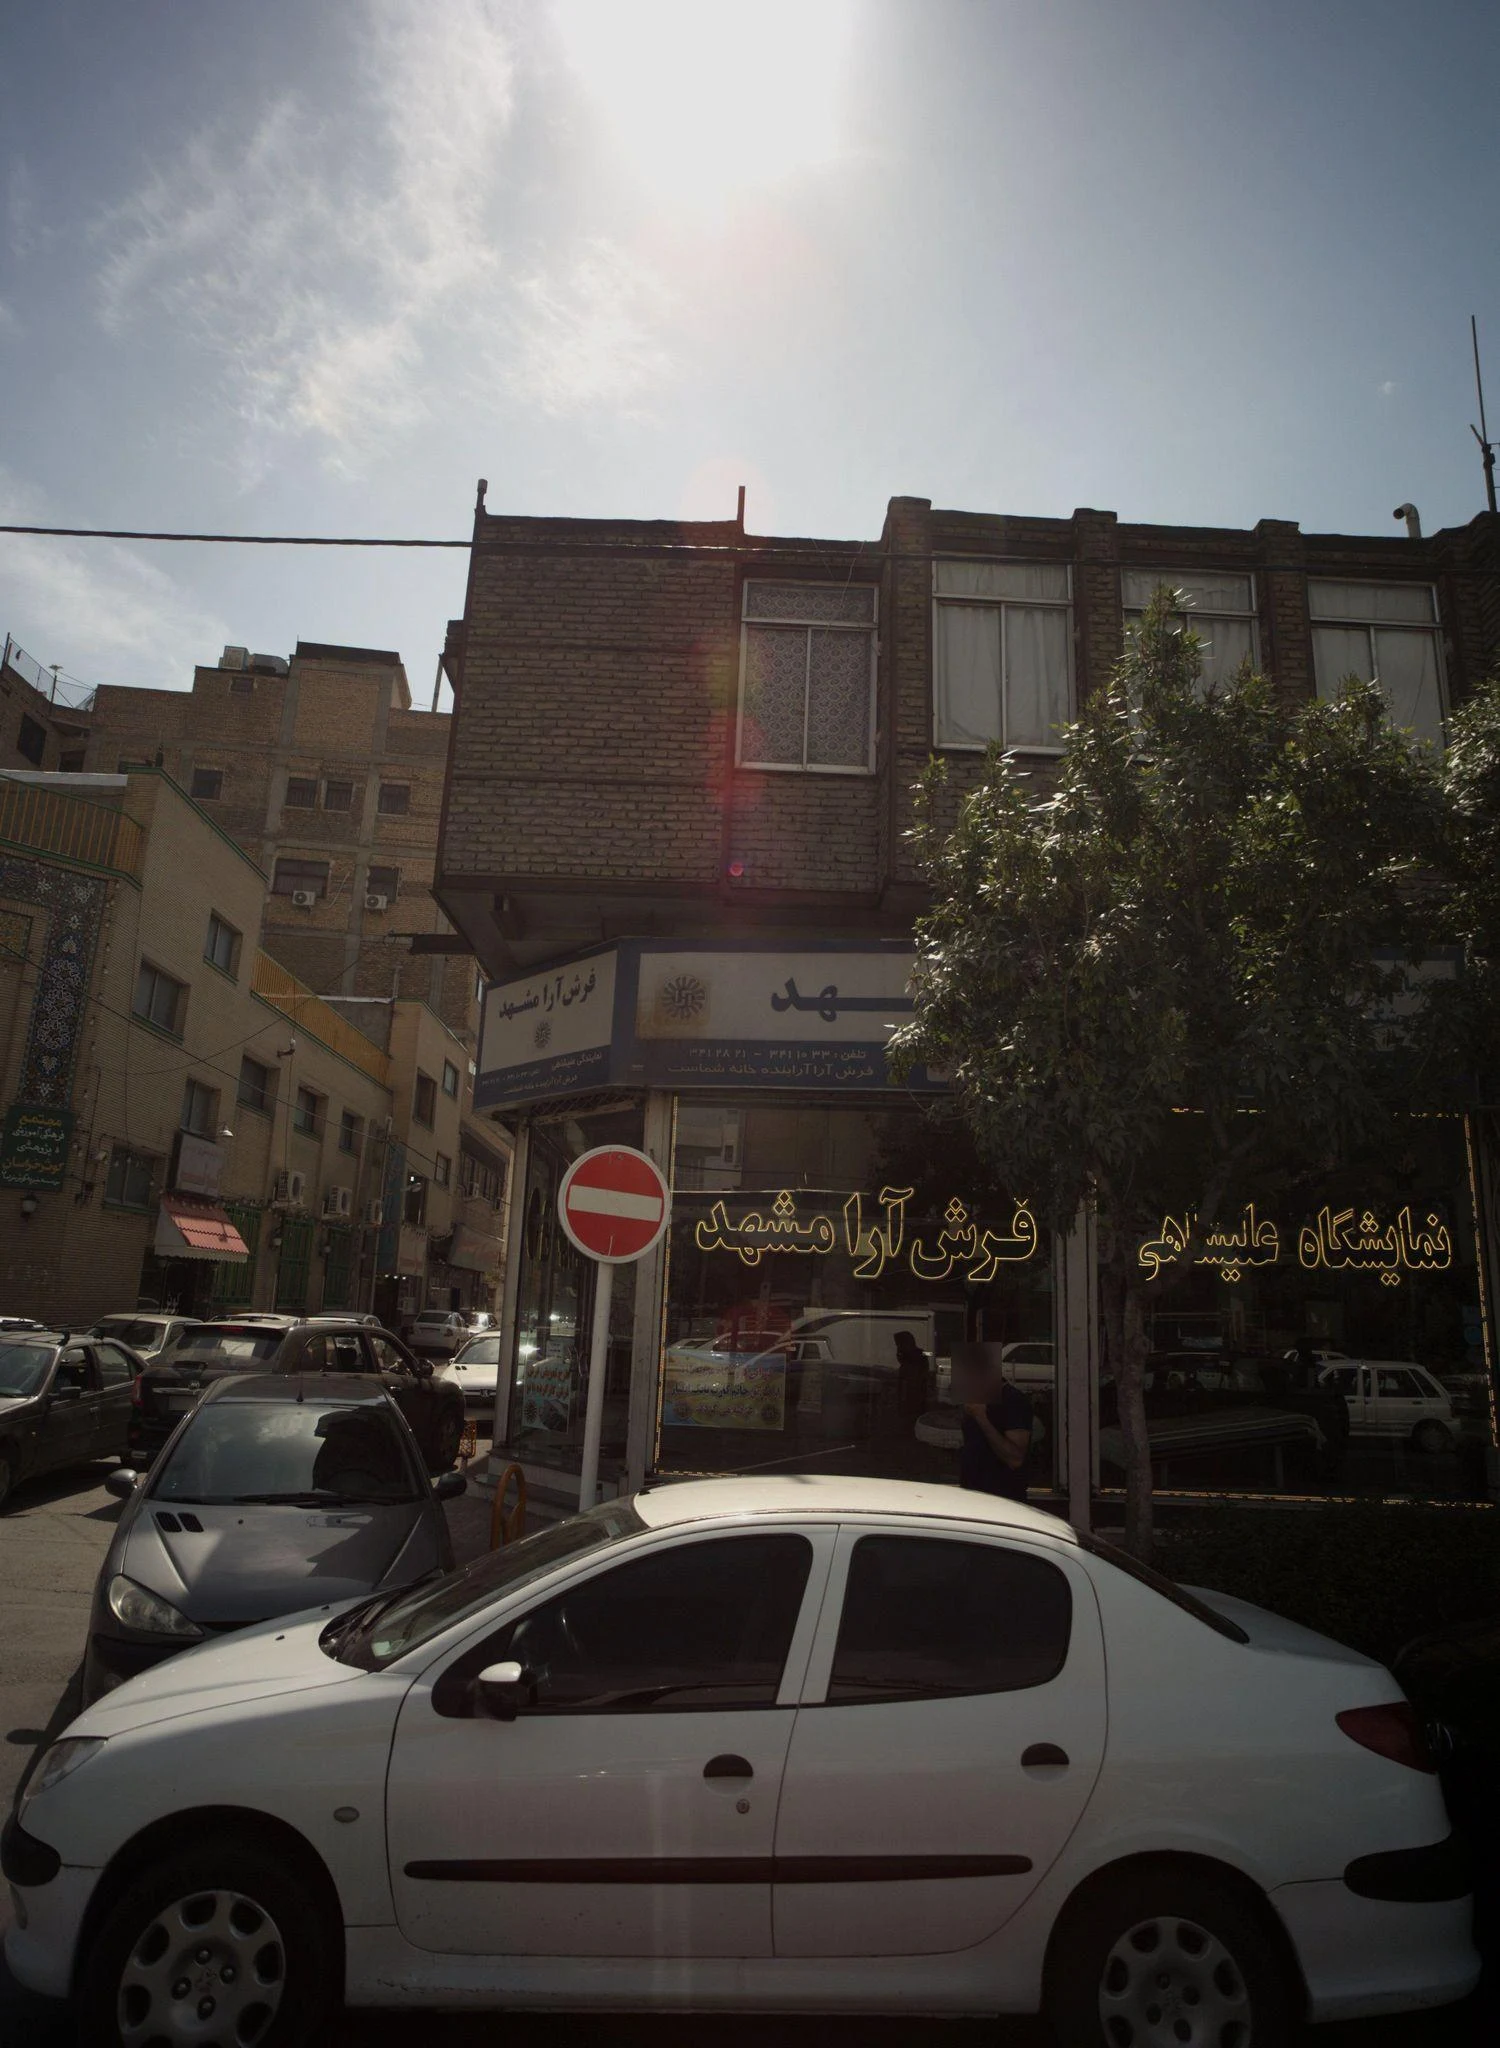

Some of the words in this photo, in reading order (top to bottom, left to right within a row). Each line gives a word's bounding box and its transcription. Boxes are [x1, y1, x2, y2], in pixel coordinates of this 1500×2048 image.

[544, 977, 564, 1012] آرا
[562, 968, 597, 1006] فرش
[499, 990, 539, 1020] مشهد
[667, 1062, 726, 1075] شماست
[729, 1064, 757, 1075] خانه
[813, 1063, 834, 1077] آرا
[835, 1064, 873, 1079] فرش
[695, 1190, 836, 1266] مشهد
[844, 1186, 915, 1279] آرا
[911, 1195, 1039, 1281] فرش
[1299, 1205, 1453, 1287] نمایشگاه
